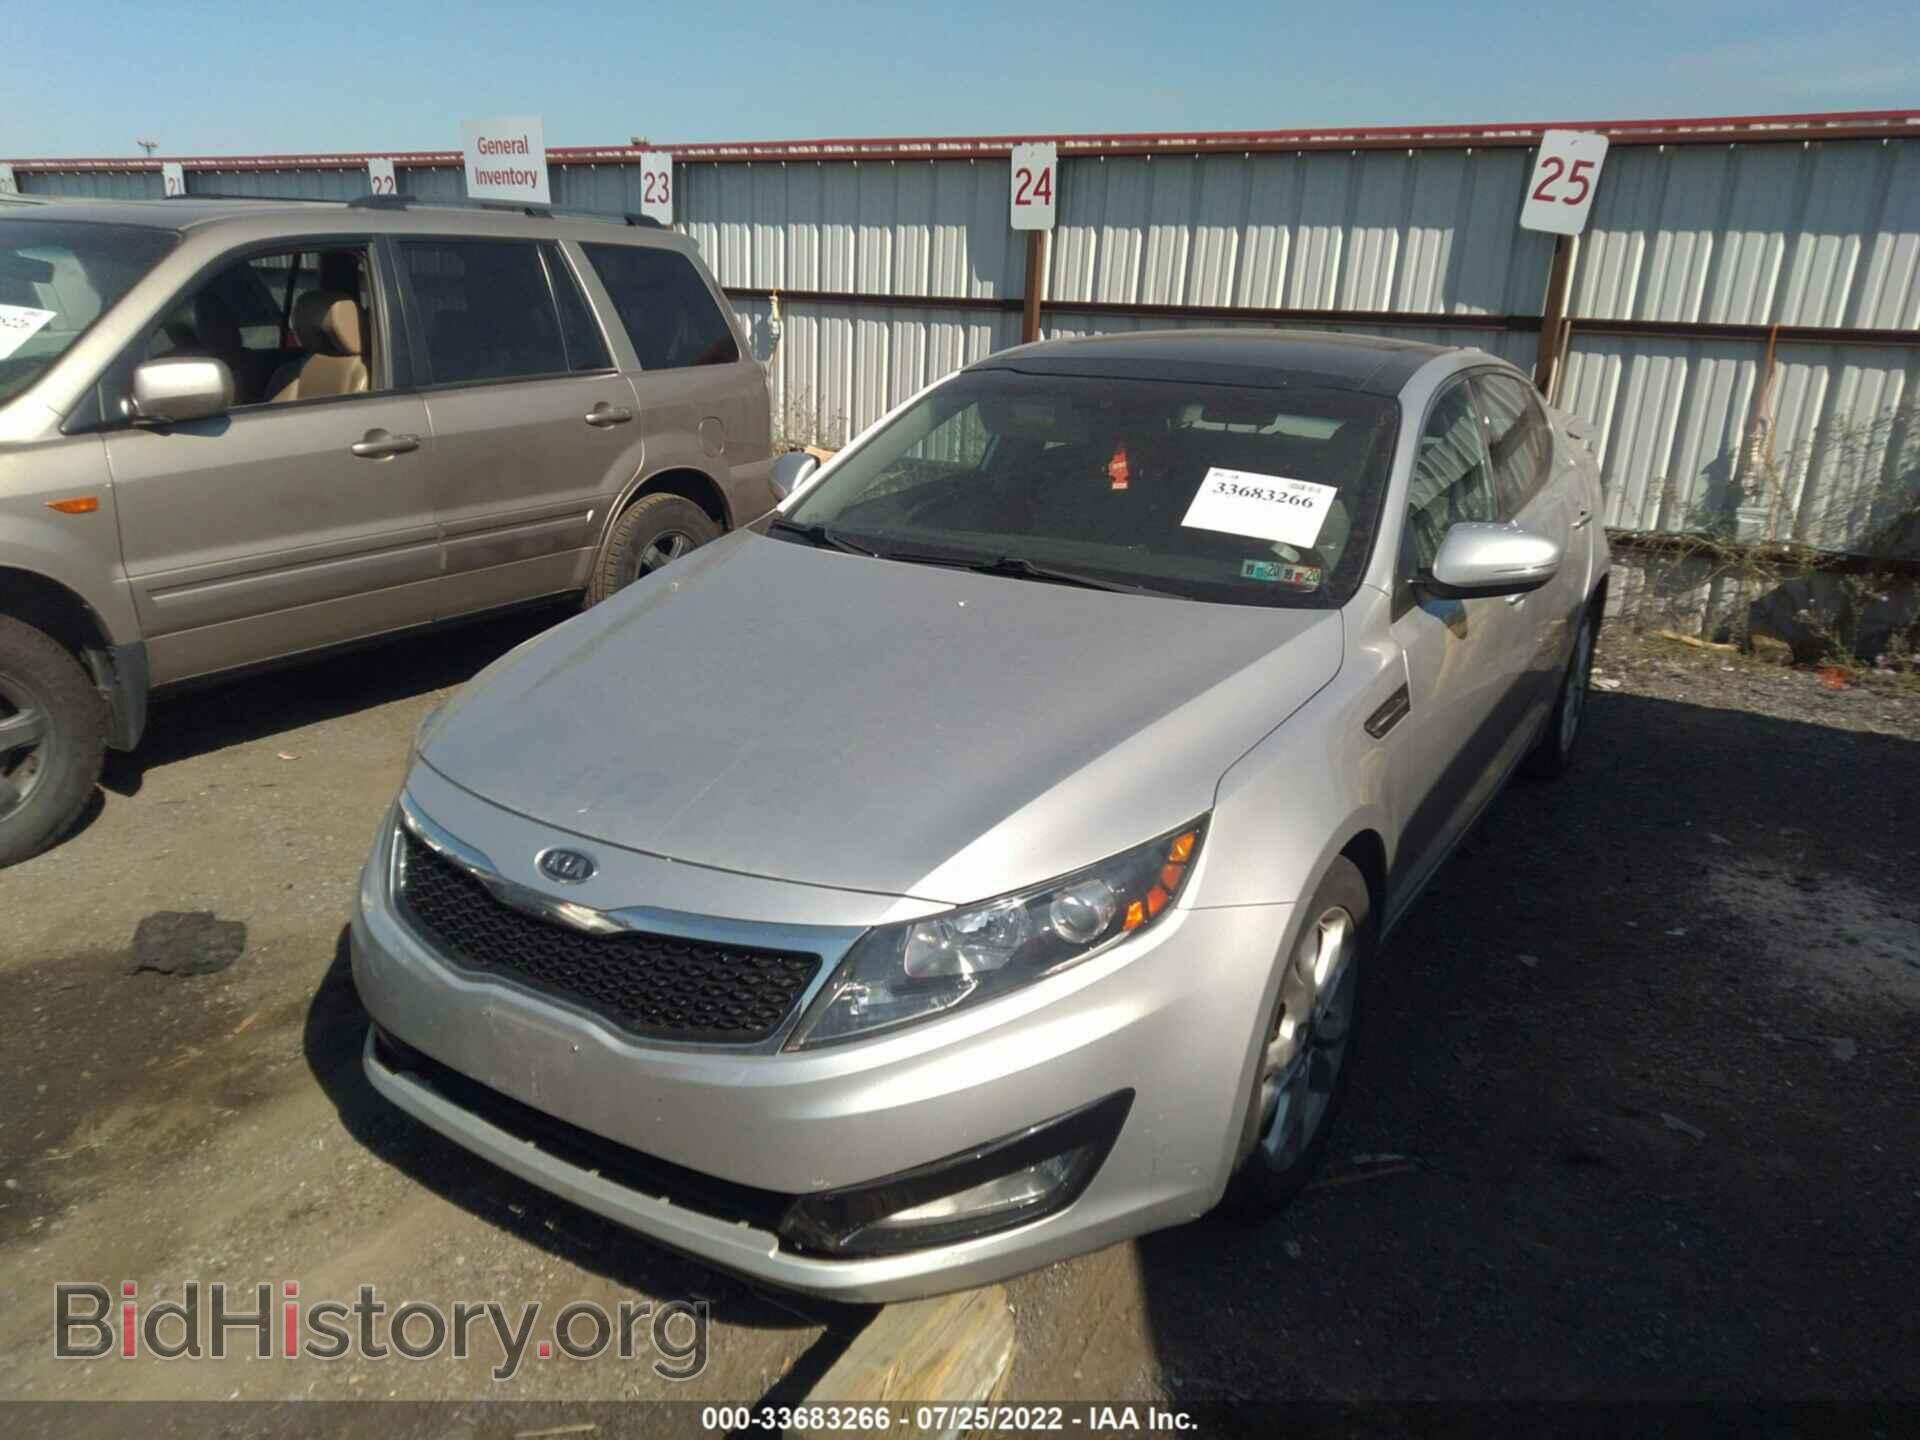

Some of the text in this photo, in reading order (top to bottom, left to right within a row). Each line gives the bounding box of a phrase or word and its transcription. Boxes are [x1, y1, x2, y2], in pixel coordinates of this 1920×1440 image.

[477, 134, 529, 155] General
[372, 175, 394, 193] 22
[475, 166, 537, 188] Inventory
[644, 171, 669, 204] 23
[1015, 167, 1052, 206] 24
[1532, 156, 1595, 205] 25
[1212, 481, 1314, 509] 33683266
